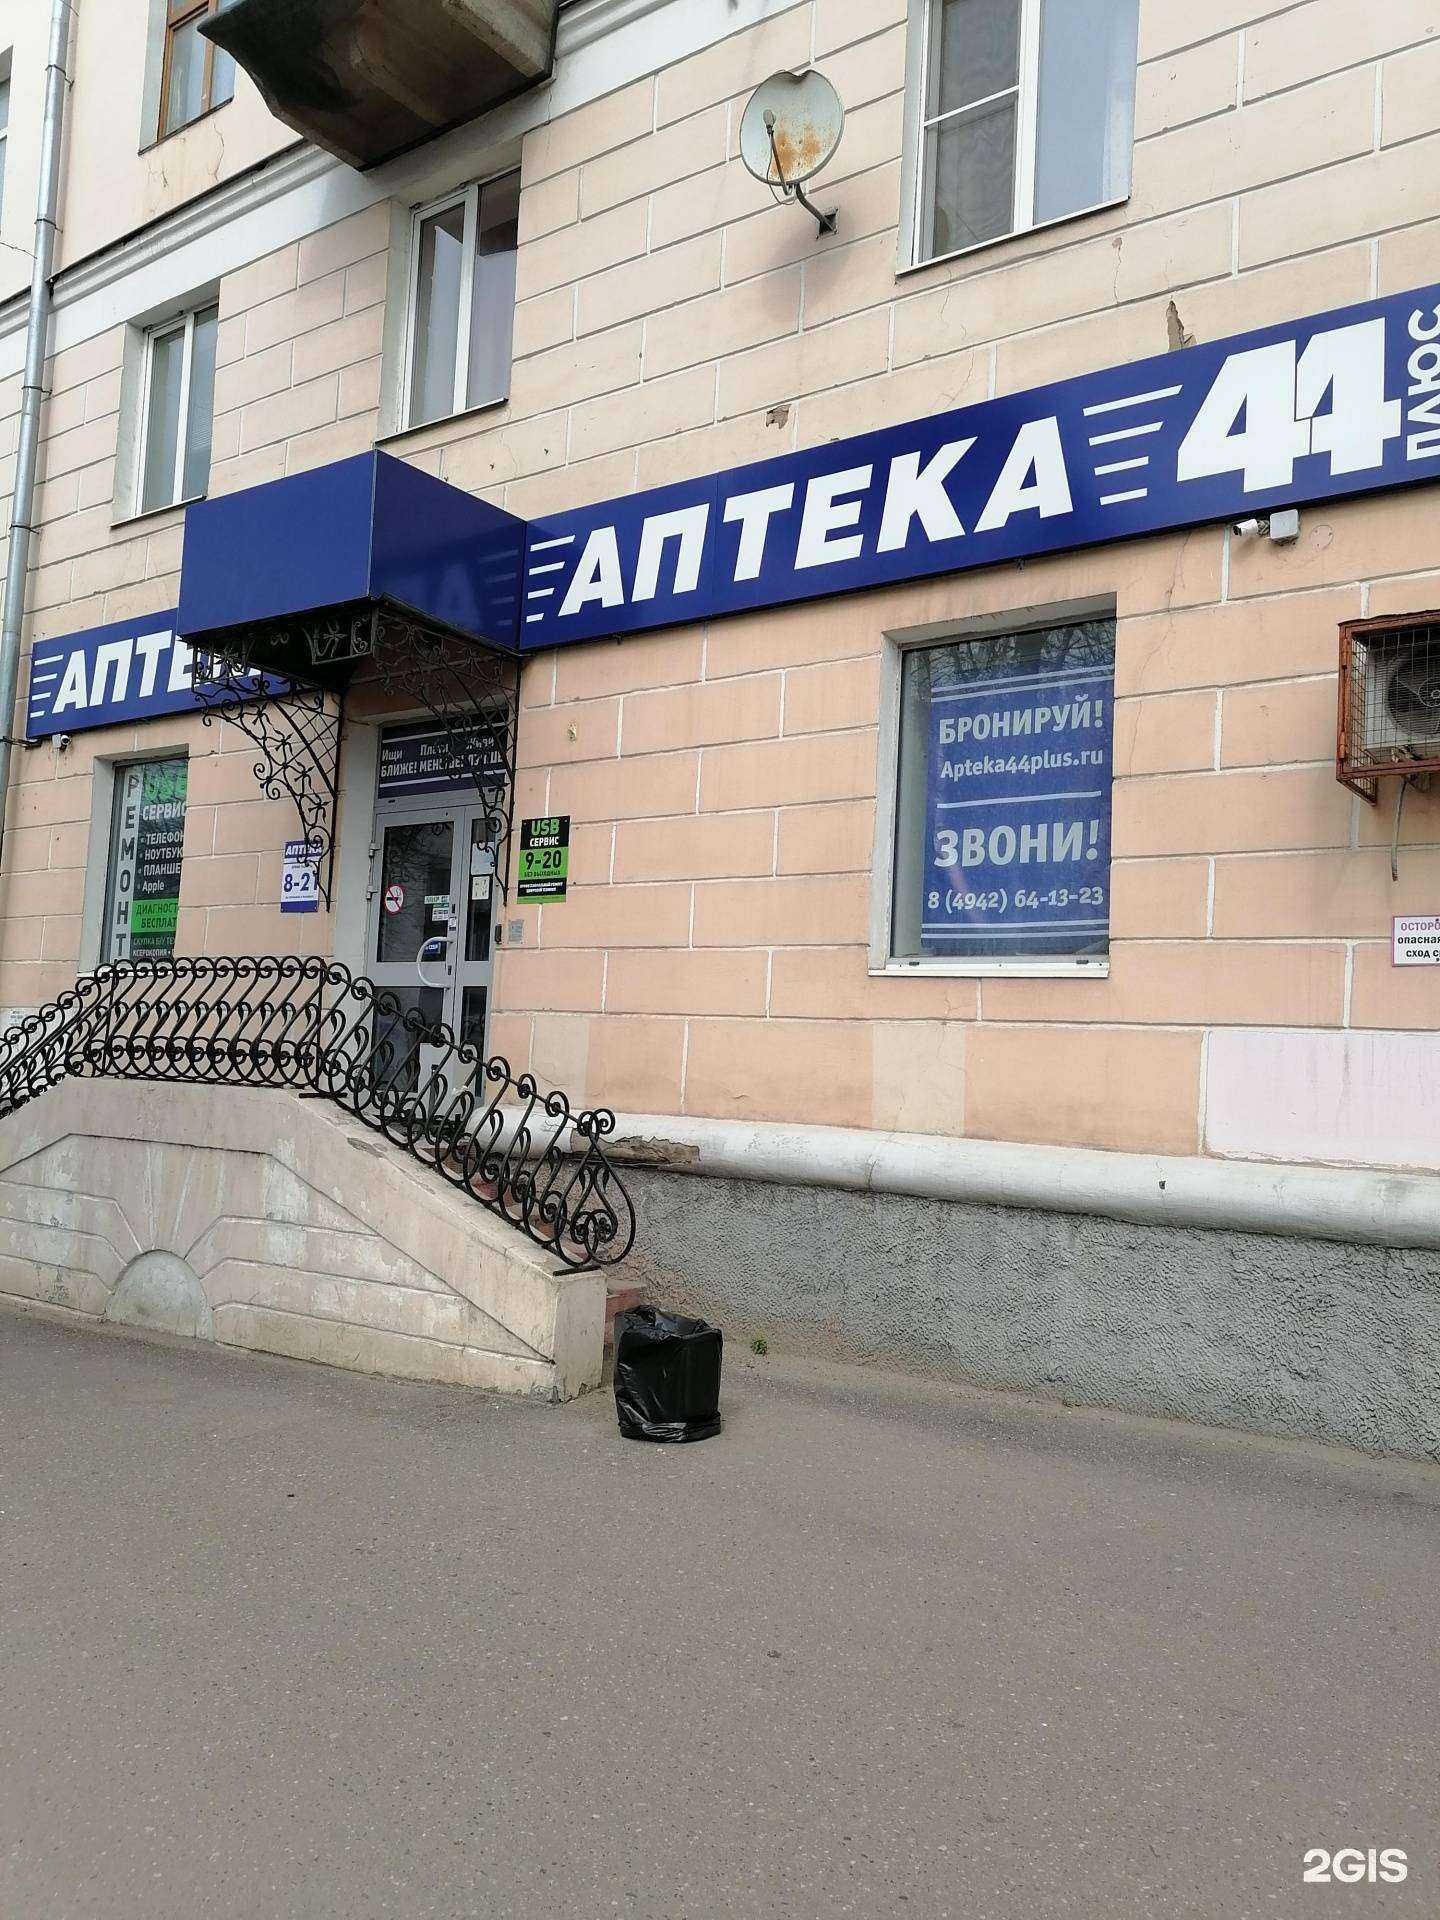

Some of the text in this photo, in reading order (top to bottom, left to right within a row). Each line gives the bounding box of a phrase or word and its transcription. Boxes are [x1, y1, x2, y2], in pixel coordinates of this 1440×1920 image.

[1407, 303, 1440, 461] ПЛЮС
[558, 317, 1402, 616] АПТЕКА 44
[939, 693, 1103, 745] БРОНИРУЙ!
[381, 748, 403, 762] Ищи
[940, 750, 1103, 783] Apteka44plus.ru
[380, 761, 417, 778] БЛИЖЕ!
[531, 818, 560, 836] USB
[529, 836, 560, 847] СЕРВИС
[934, 819, 1100, 868] ЗВОНИ!
[116, 775, 139, 957] РЕМОНТ
[525, 849, 562, 870] 9-20
[142, 880, 165, 894] Apple
[928, 886, 1104, 914] 8 (4942) 64-13-23
[1406, 950, 1431, 959] сход
